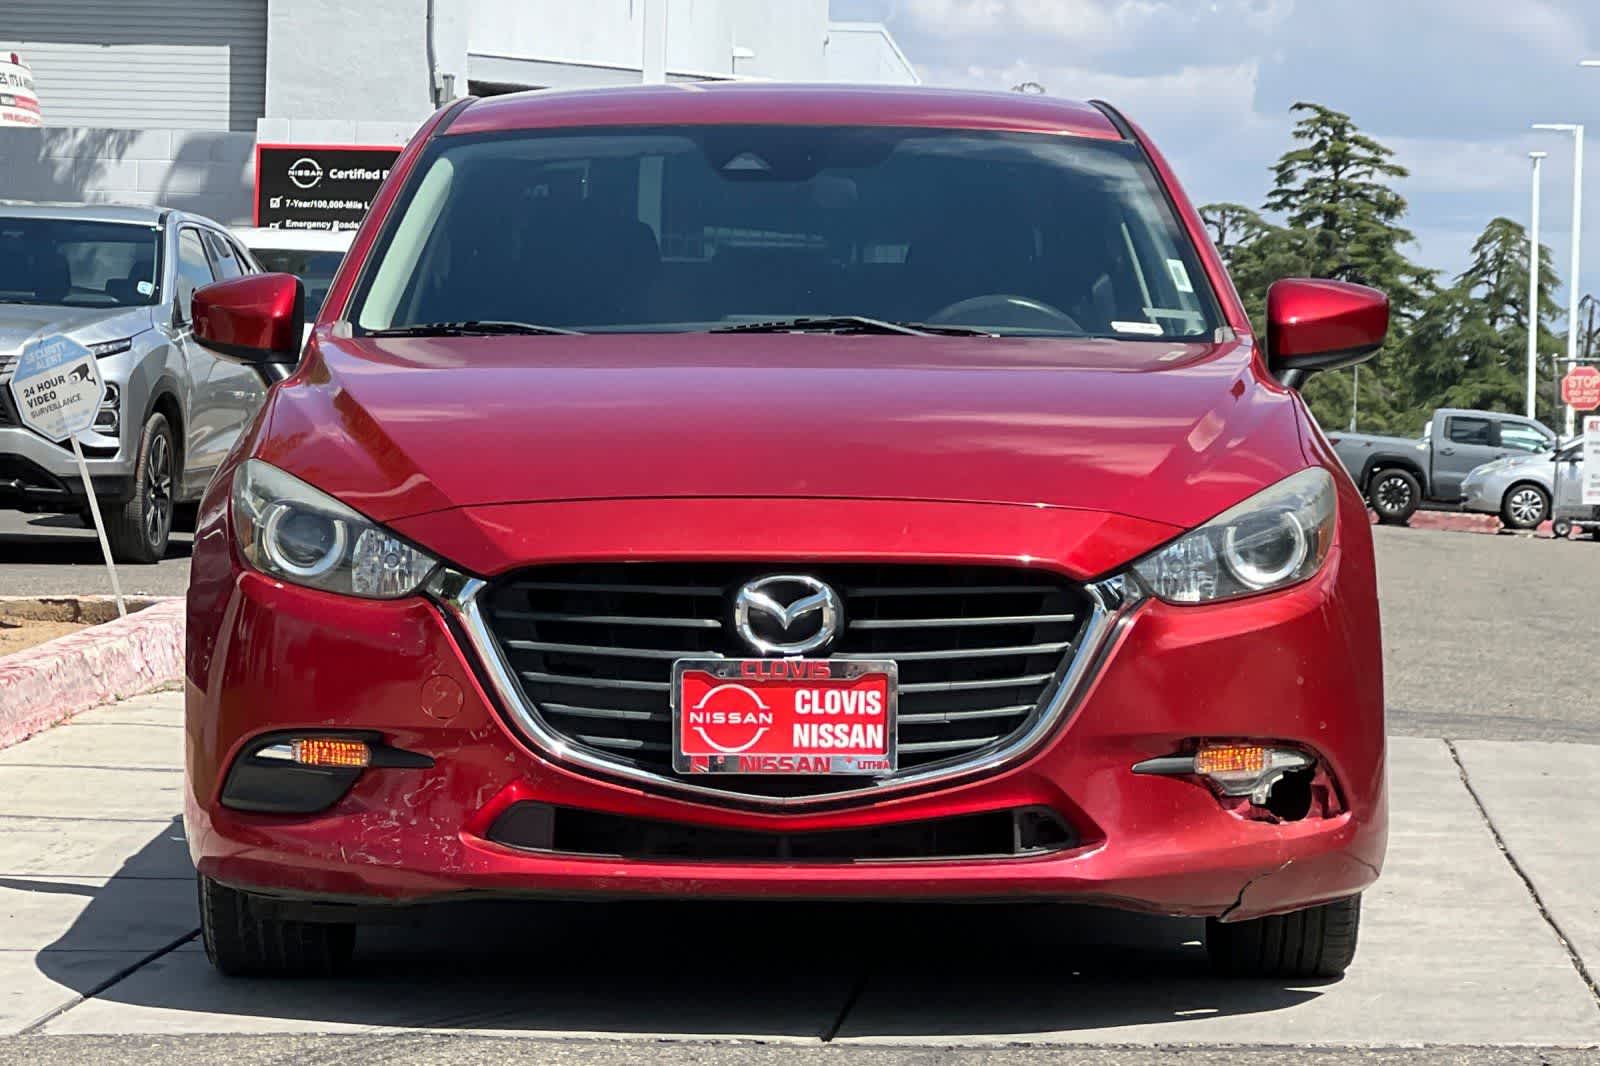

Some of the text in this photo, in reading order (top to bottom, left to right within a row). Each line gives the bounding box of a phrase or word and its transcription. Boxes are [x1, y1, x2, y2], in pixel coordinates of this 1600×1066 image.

[329, 168, 380, 179] Certified
[285, 199, 363, 210] 7-Year/100,000-Mile
[285, 219, 331, 230] Emergency
[24, 376, 66, 398] 24 HOUR
[1568, 376, 1600, 389] STOP
[27, 390, 57, 408] VIDEO
[31, 392, 81, 418] SURVEILLANCE
[740, 660, 831, 679] CLOVIS
[794, 690, 882, 715] CLOVIS
[689, 711, 774, 725] NISSAN
[792, 723, 884, 749] NISSAN
[738, 756, 832, 773] NISSAN
[857, 760, 890, 770] LITHIA
